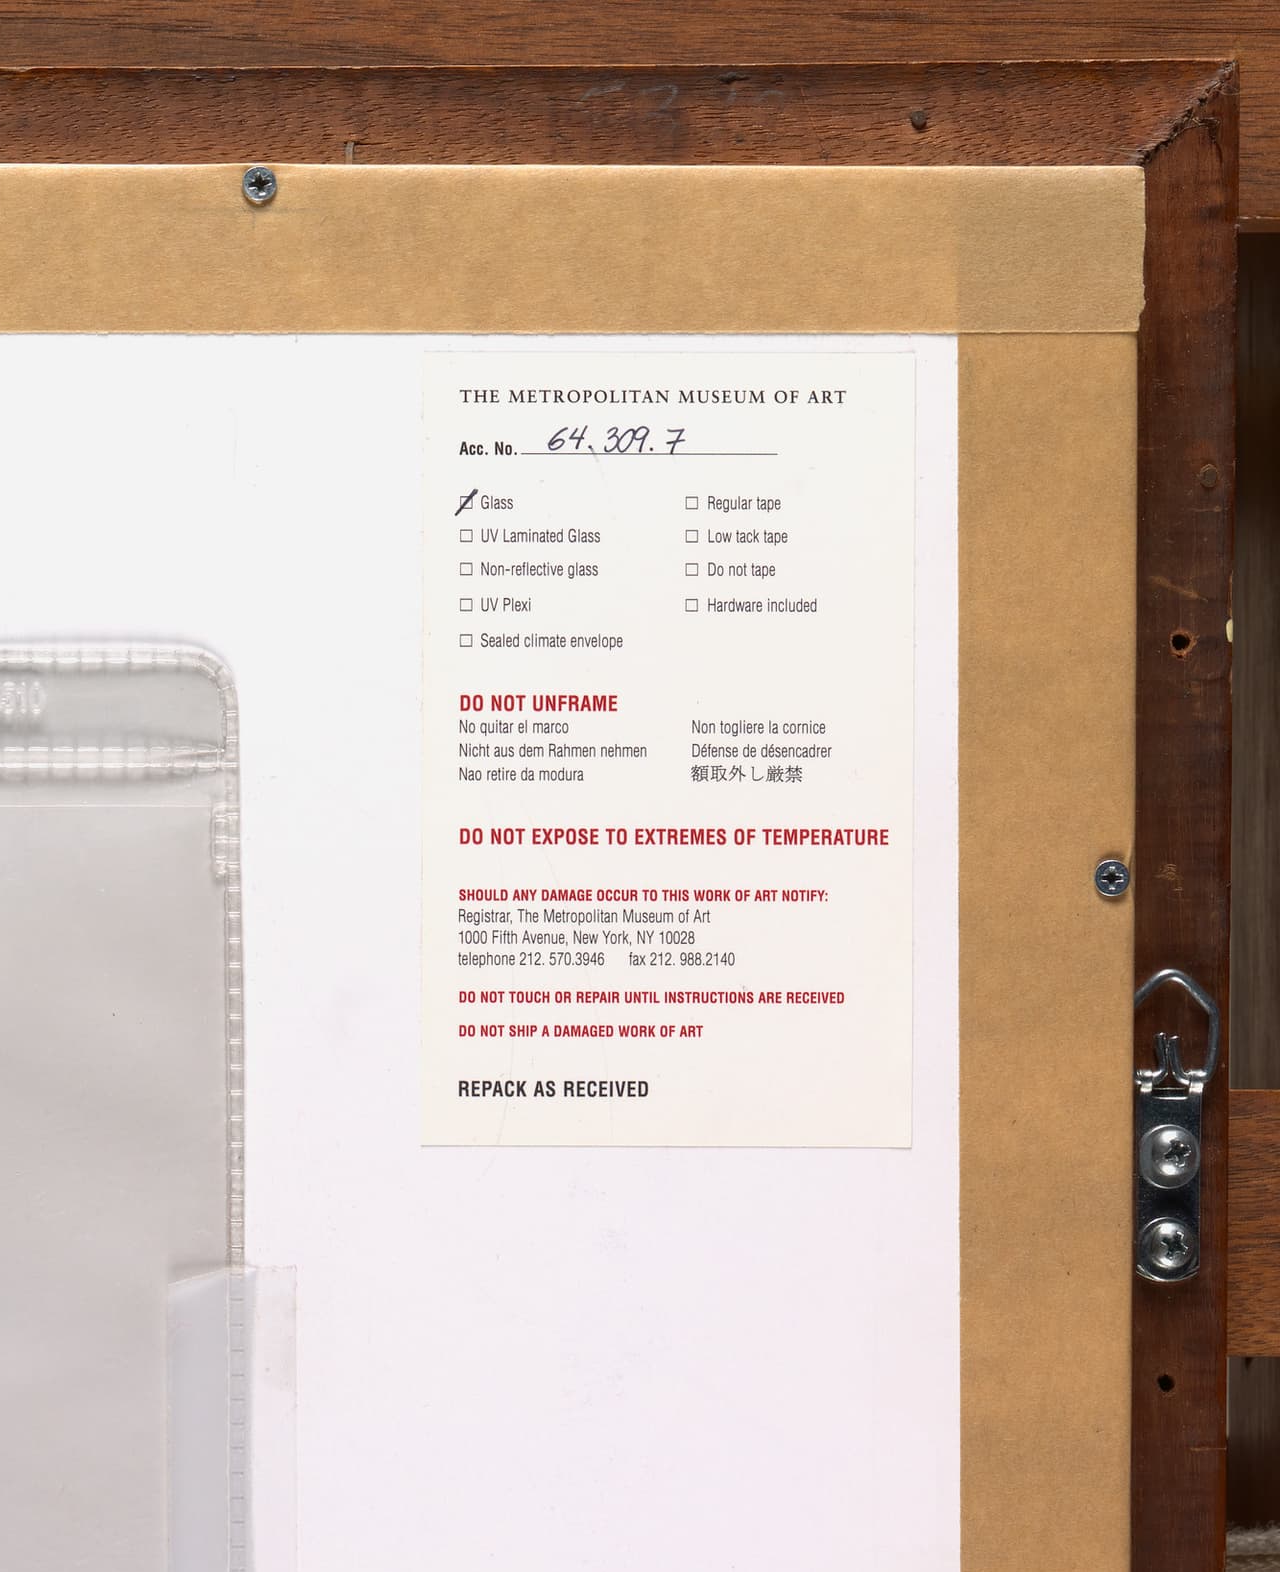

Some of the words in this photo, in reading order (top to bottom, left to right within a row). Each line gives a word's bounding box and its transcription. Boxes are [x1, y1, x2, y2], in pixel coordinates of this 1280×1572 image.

[459, 389, 500, 404] THE
[508, 389, 670, 404] METROPOLITAN
[678, 389, 766, 404] MUSEUM
[774, 390, 800, 404] OF
[807, 390, 847, 404] ART
[459, 441, 489, 456] Acc.
[494, 441, 518, 456] No.
[480, 494, 514, 510] Glass
[707, 495, 753, 514] Regular
[756, 496, 782, 513] tape
[481, 528, 499, 544] UV
[503, 528, 564, 544] Laminated
[567, 527, 601, 544] Glass
[707, 528, 733, 544] Low
[735, 528, 760, 544] tack
[763, 529, 788, 547] tape
[480, 561, 564, 577] Non-reflective
[567, 561, 599, 580] glass
[707, 561, 725, 577] Do
[728, 562, 748, 577] not
[750, 562, 776, 580] tape
[707, 597, 763, 613] Hardware
[767, 597, 818, 613] included
[480, 632, 520, 648] Sealed
[523, 632, 567, 648] climate
[570, 633, 624, 651] envelope
[459, 694, 484, 712] DO
[491, 694, 527, 712] NOT
[532, 694, 618, 712] UNFRAME
[459, 719, 476, 734] No
[479, 719, 515, 737] quitar
[517, 719, 528, 734] el
[532, 722, 570, 735] marco
[691, 719, 716, 735] Non
[719, 719, 765, 738] togliere
[768, 719, 779, 735] la
[782, 722, 826, 735] cornice
[458, 742, 490, 758] Nicht
[493, 745, 515, 758] aus
[518, 743, 545, 758] dem
[548, 742, 596, 758] Rahmen
[600, 743, 648, 758] nehmen
[691, 743, 739, 758] Défense
[742, 743, 757, 758] de
[760, 743, 833, 759] désencadrer
[458, 766, 483, 782] Nao
[486, 767, 517, 782] retire
[520, 767, 535, 782] da
[538, 767, 584, 782] modura
[690, 764, 803, 784] 額取外し厳禁
[459, 827, 484, 846] DO
[490, 827, 526, 846] NOT
[531, 827, 600, 846] EXPOSE
[605, 827, 628, 846] TO
[634, 828, 727, 846] EXTREMES
[733, 828, 757, 846] OF
[761, 828, 889, 846] TEMPERATURE
[458, 888, 509, 902] SHOULD
[512, 888, 538, 902] ANY
[541, 888, 593, 902] DAMAGE
[596, 888, 638, 902] OCCUR
[641, 889, 658, 902] TO
[661, 889, 690, 902] THIS
[693, 889, 731, 902] WORK
[734, 889, 751, 902] OF
[754, 889, 779, 902] ART
[781, 889, 829, 902] NOTIFY:
[458, 908, 513, 927] Registrar,
[516, 908, 539, 924] The
[543, 908, 618, 927] Metropolitan
[622, 908, 674, 924] Museum
[678, 908, 690, 924] of
[693, 908, 711, 924] Art
[458, 929, 488, 945] 1000
[491, 929, 518, 945] Fifth
[521, 929, 569, 947] Avenue,
[573, 929, 599, 945] New
[602, 929, 632, 947] York,
[636, 929, 655, 945] NY
[659, 930, 696, 945] 10028
[458, 990, 476, 1004] DO
[480, 990, 506, 1004] NOT
[508, 990, 551, 1004] TOUCH
[554, 990, 572, 1004] OR
[576, 991, 620, 1004] REPAIR
[624, 991, 661, 1004] UNTIL
[664, 991, 755, 1004] INSTRUCTIONS
[757, 991, 782, 1004] ARE
[786, 991, 845, 1005] RECEIVED
[458, 1079, 527, 1098] REPACK
[533, 1080, 556, 1098] AS
[563, 1080, 649, 1098] RECEIVED
